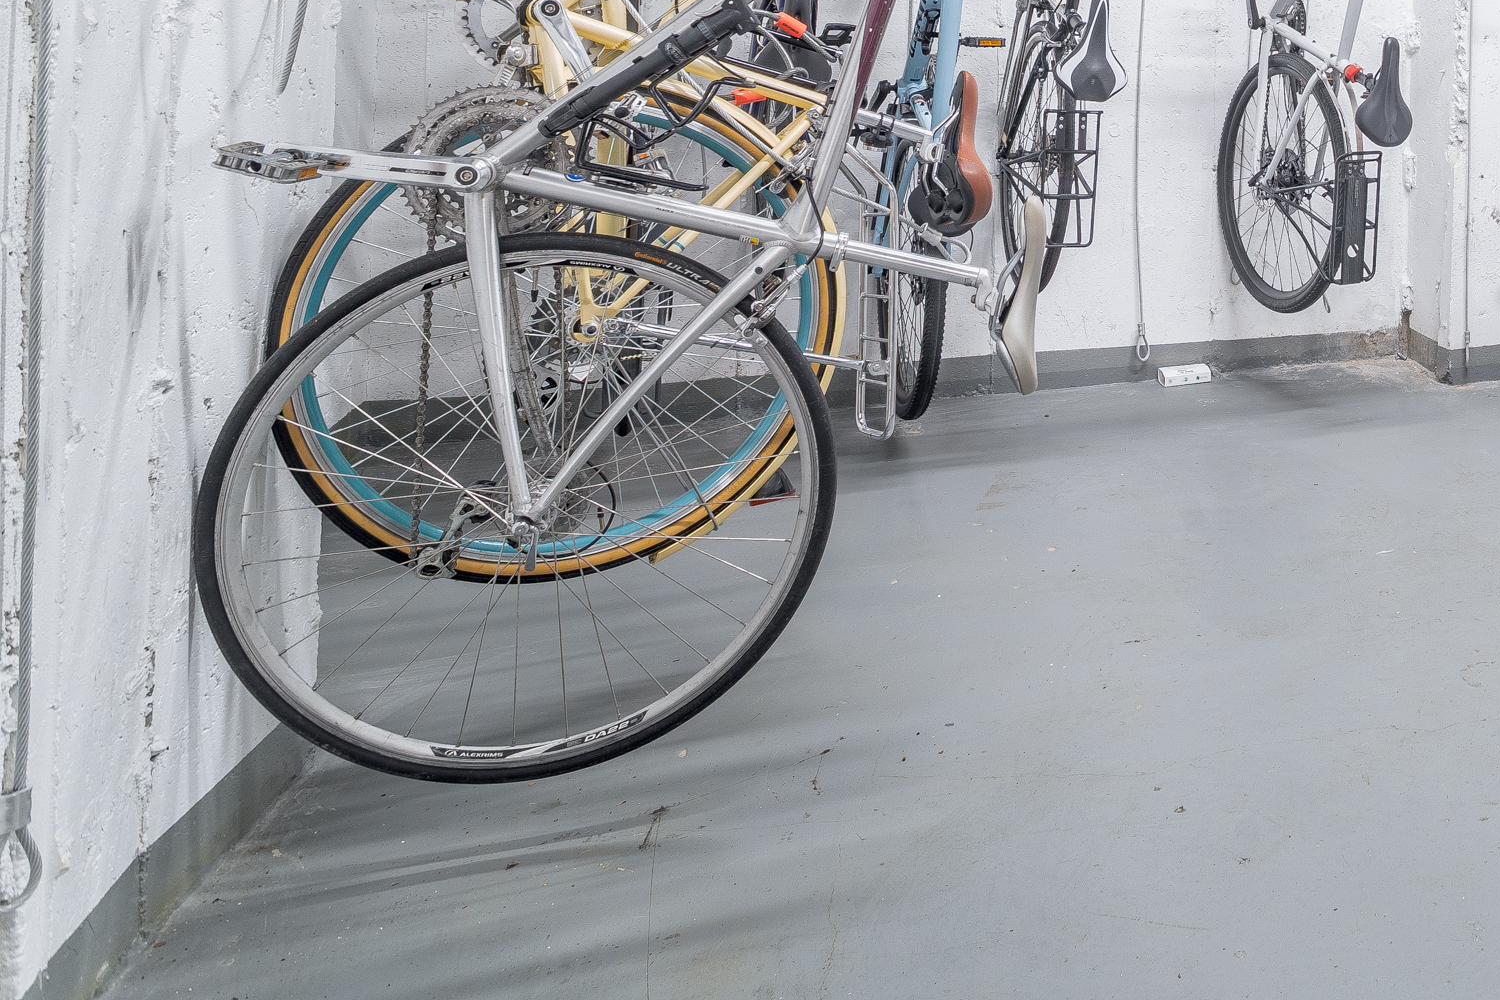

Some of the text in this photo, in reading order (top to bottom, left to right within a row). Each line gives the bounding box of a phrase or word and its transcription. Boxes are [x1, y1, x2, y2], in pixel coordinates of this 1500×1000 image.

[569, 260, 612, 269] ALEXRIMS
[666, 262, 710, 285] ULTRA
[459, 751, 504, 759] ALEXRIMS
